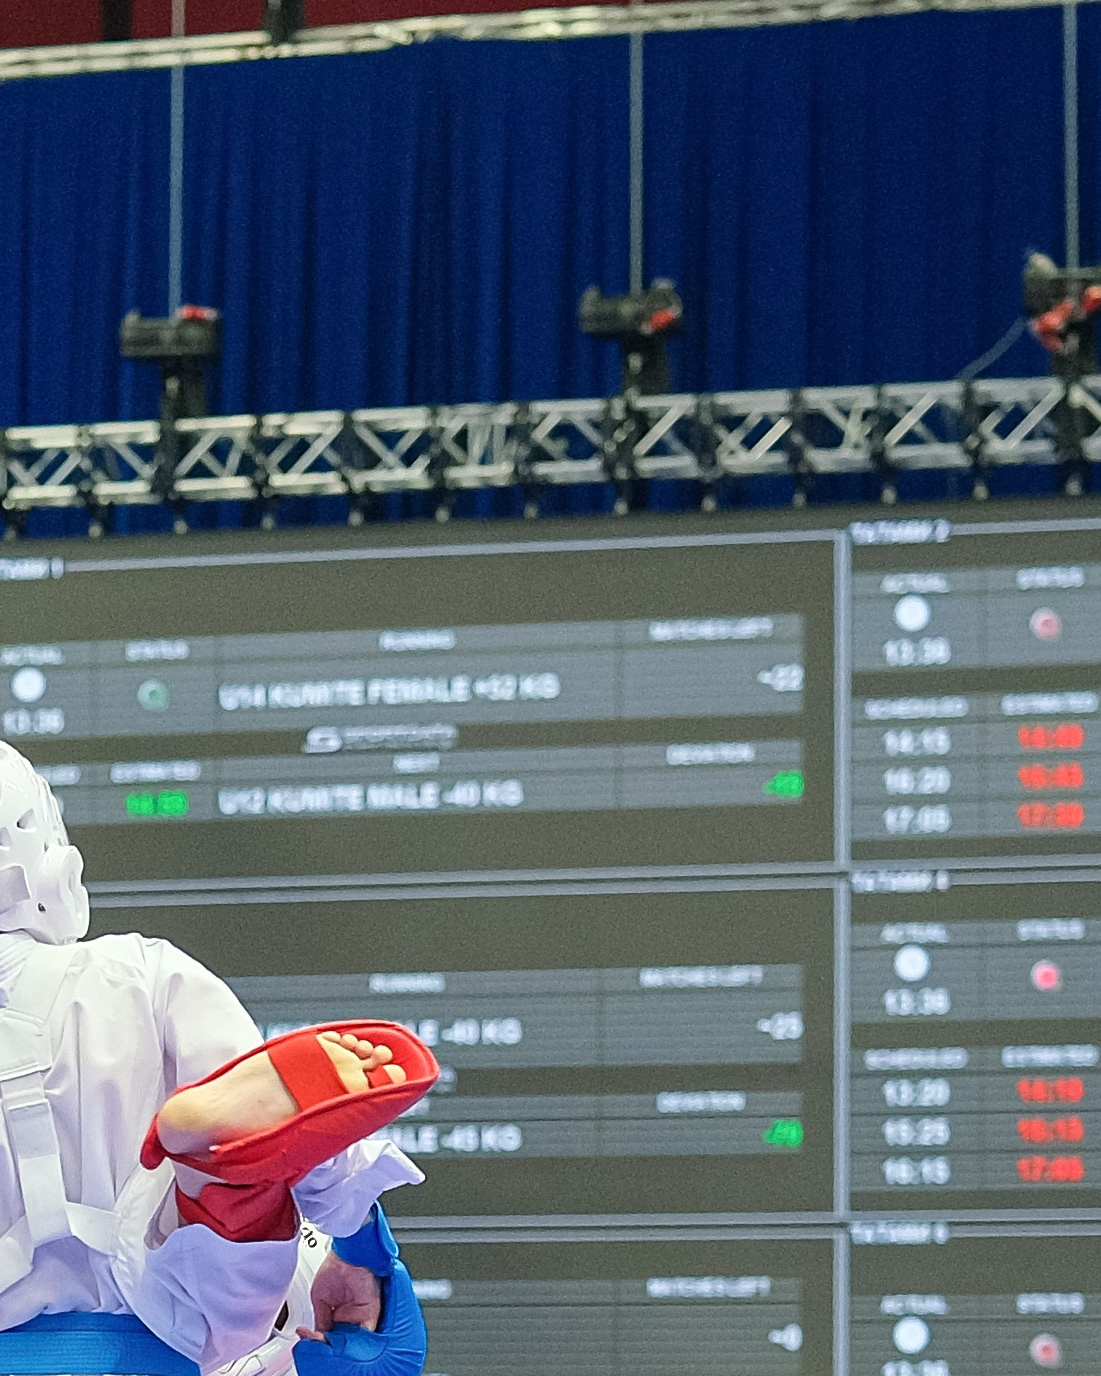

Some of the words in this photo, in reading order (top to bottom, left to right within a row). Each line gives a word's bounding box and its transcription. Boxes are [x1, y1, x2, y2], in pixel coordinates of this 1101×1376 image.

[219, 684, 266, 710] U14
[268, 680, 365, 709] KUMITE
[368, 675, 470, 704] FEMALE
[519, 672, 560, 699] KG
[267, 784, 364, 812] KUMITE
[367, 781, 440, 810] MALE
[483, 779, 523, 806] KG
[482, 1017, 522, 1045] KG
[482, 1124, 522, 1152] KG
